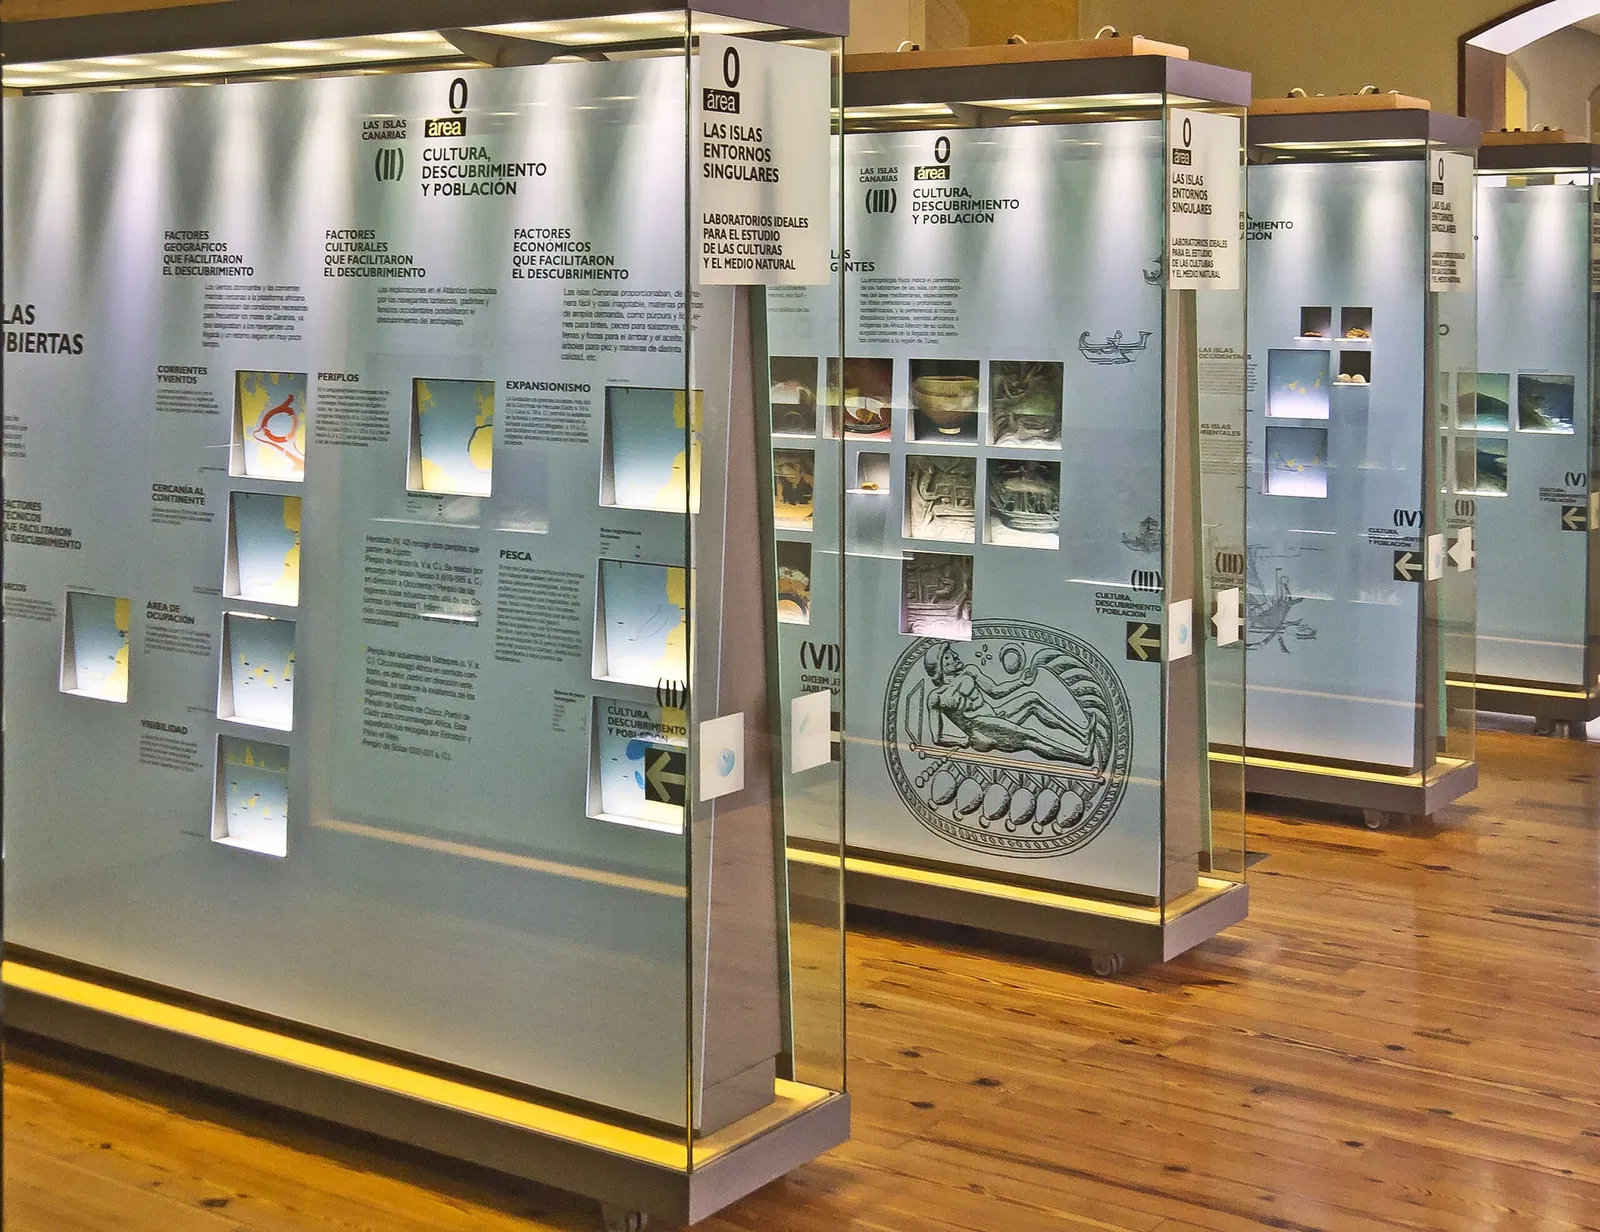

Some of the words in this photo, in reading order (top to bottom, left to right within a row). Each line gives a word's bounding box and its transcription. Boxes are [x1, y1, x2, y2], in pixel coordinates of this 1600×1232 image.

[723, 46, 740, 89] 0
[449, 77, 468, 114] 0
[706, 90, 736, 112] área
[363, 120, 379, 130] LAS
[382, 119, 407, 129] ISLAS
[428, 118, 462, 137] área
[362, 129, 406, 140] CANARIAS
[703, 122, 727, 139] LAS
[729, 125, 763, 143] ISLAS
[1183, 117, 1192, 148] 0
[423, 146, 491, 162] CULTURA,
[703, 143, 771, 163] ENTORNOS
[934, 136, 951, 164] 0
[1173, 149, 1191, 165] área
[375, 148, 405, 182] (II)
[422, 163, 547, 179] DESCUBRIMIENTO
[703, 163, 779, 183] SINGULARES
[859, 175, 898, 183] CANARIAS
[917, 167, 946, 180] área
[1172, 173, 1185, 185] LAS
[1186, 174, 1204, 186] ISLAS
[421, 183, 430, 197] Y
[433, 178, 517, 197] POBLACIÓN
[912, 187, 972, 199] CULTURA,
[1172, 187, 1208, 201] ENTORNOS
[865, 188, 897, 214] (III)
[912, 199, 1020, 212] DESCUBRIMIENTO
[1172, 202, 1212, 215] SINGULARES
[703, 213, 772, 228] LABORATORIOS
[774, 215, 809, 228] IDEALES
[912, 214, 920, 225] Y
[923, 210, 994, 225] POBLACIÓN
[164, 230, 209, 241] FACTORES
[325, 229, 375, 240] FACTORES
[514, 228, 571, 239] FACTORES
[703, 228, 728, 240] PARA
[729, 229, 740, 241] EL
[742, 230, 780, 242] ESTUDIO
[325, 242, 388, 252] CULTURALES
[513, 239, 591, 253] ECONÓMICOS
[703, 243, 716, 255] DE
[718, 243, 735, 255] LAS
[737, 244, 783, 256] CULTURAS
[1172, 238, 1208, 247] LABORATORIOS
[1208, 239, 1228, 248] IDEALES
[163, 255, 183, 265] QUE
[184, 254, 243, 264] FACILITARON
[324, 255, 346, 265] QUE
[347, 255, 413, 265] FACILITARON
[830, 249, 851, 259] LS
[1172, 249, 1185, 257] PARA
[1185, 249, 1192, 257] EL
[1192, 249, 1213, 258] ESTUDIO
[513, 255, 536, 267] QUE
[539, 255, 614, 266] FACILITARON
[703, 257, 710, 269] Y
[711, 257, 722, 269] EL
[724, 258, 754, 270] MEDIO
[755, 258, 796, 271] NATURAL
[830, 261, 875, 272] GNTES
[1172, 259, 1179, 267] DE
[1179, 259, 1189, 268] LAS
[1190, 260, 1214, 268] CULTURAS
[162, 267, 173, 276] EL
[174, 267, 254, 277] DESCUBRIMIENTO
[324, 267, 335, 277] EL
[337, 267, 426, 278] DESCUBRIMIENTO
[512, 269, 525, 279] EL
[527, 269, 629, 280] DESCUBRIMIENTO
[1172, 270, 1176, 278] Y
[1176, 270, 1183, 278] EL
[1183, 270, 1199, 278] MEDIO
[1199, 270, 1221, 279] NATURAL
[157, 365, 208, 375] CORRIENTES
[317, 372, 359, 383] PERIPLOS
[506, 380, 591, 392] EXPANSIONISMO
[1565, 471, 1587, 487] (V)
[4, 500, 41, 511] ACTORES
[151, 494, 205, 505] CONTINENTE
[1393, 509, 1423, 528] (IV)
[499, 550, 533, 562] PESCA
[1131, 569, 1162, 594] (III)
[1095, 592, 1132, 602] CULTURA,
[169, 603, 181, 613] DE
[1095, 600, 1162, 612] DESCUBRIMIENTO
[656, 677, 687, 710] (II)
[608, 706, 651, 721] CULTURA,
[140, 719, 188, 735] VISIBILIDAD
[607, 717, 687, 735] DESCUBRIMIENTO
[608, 727, 614, 736] Y
